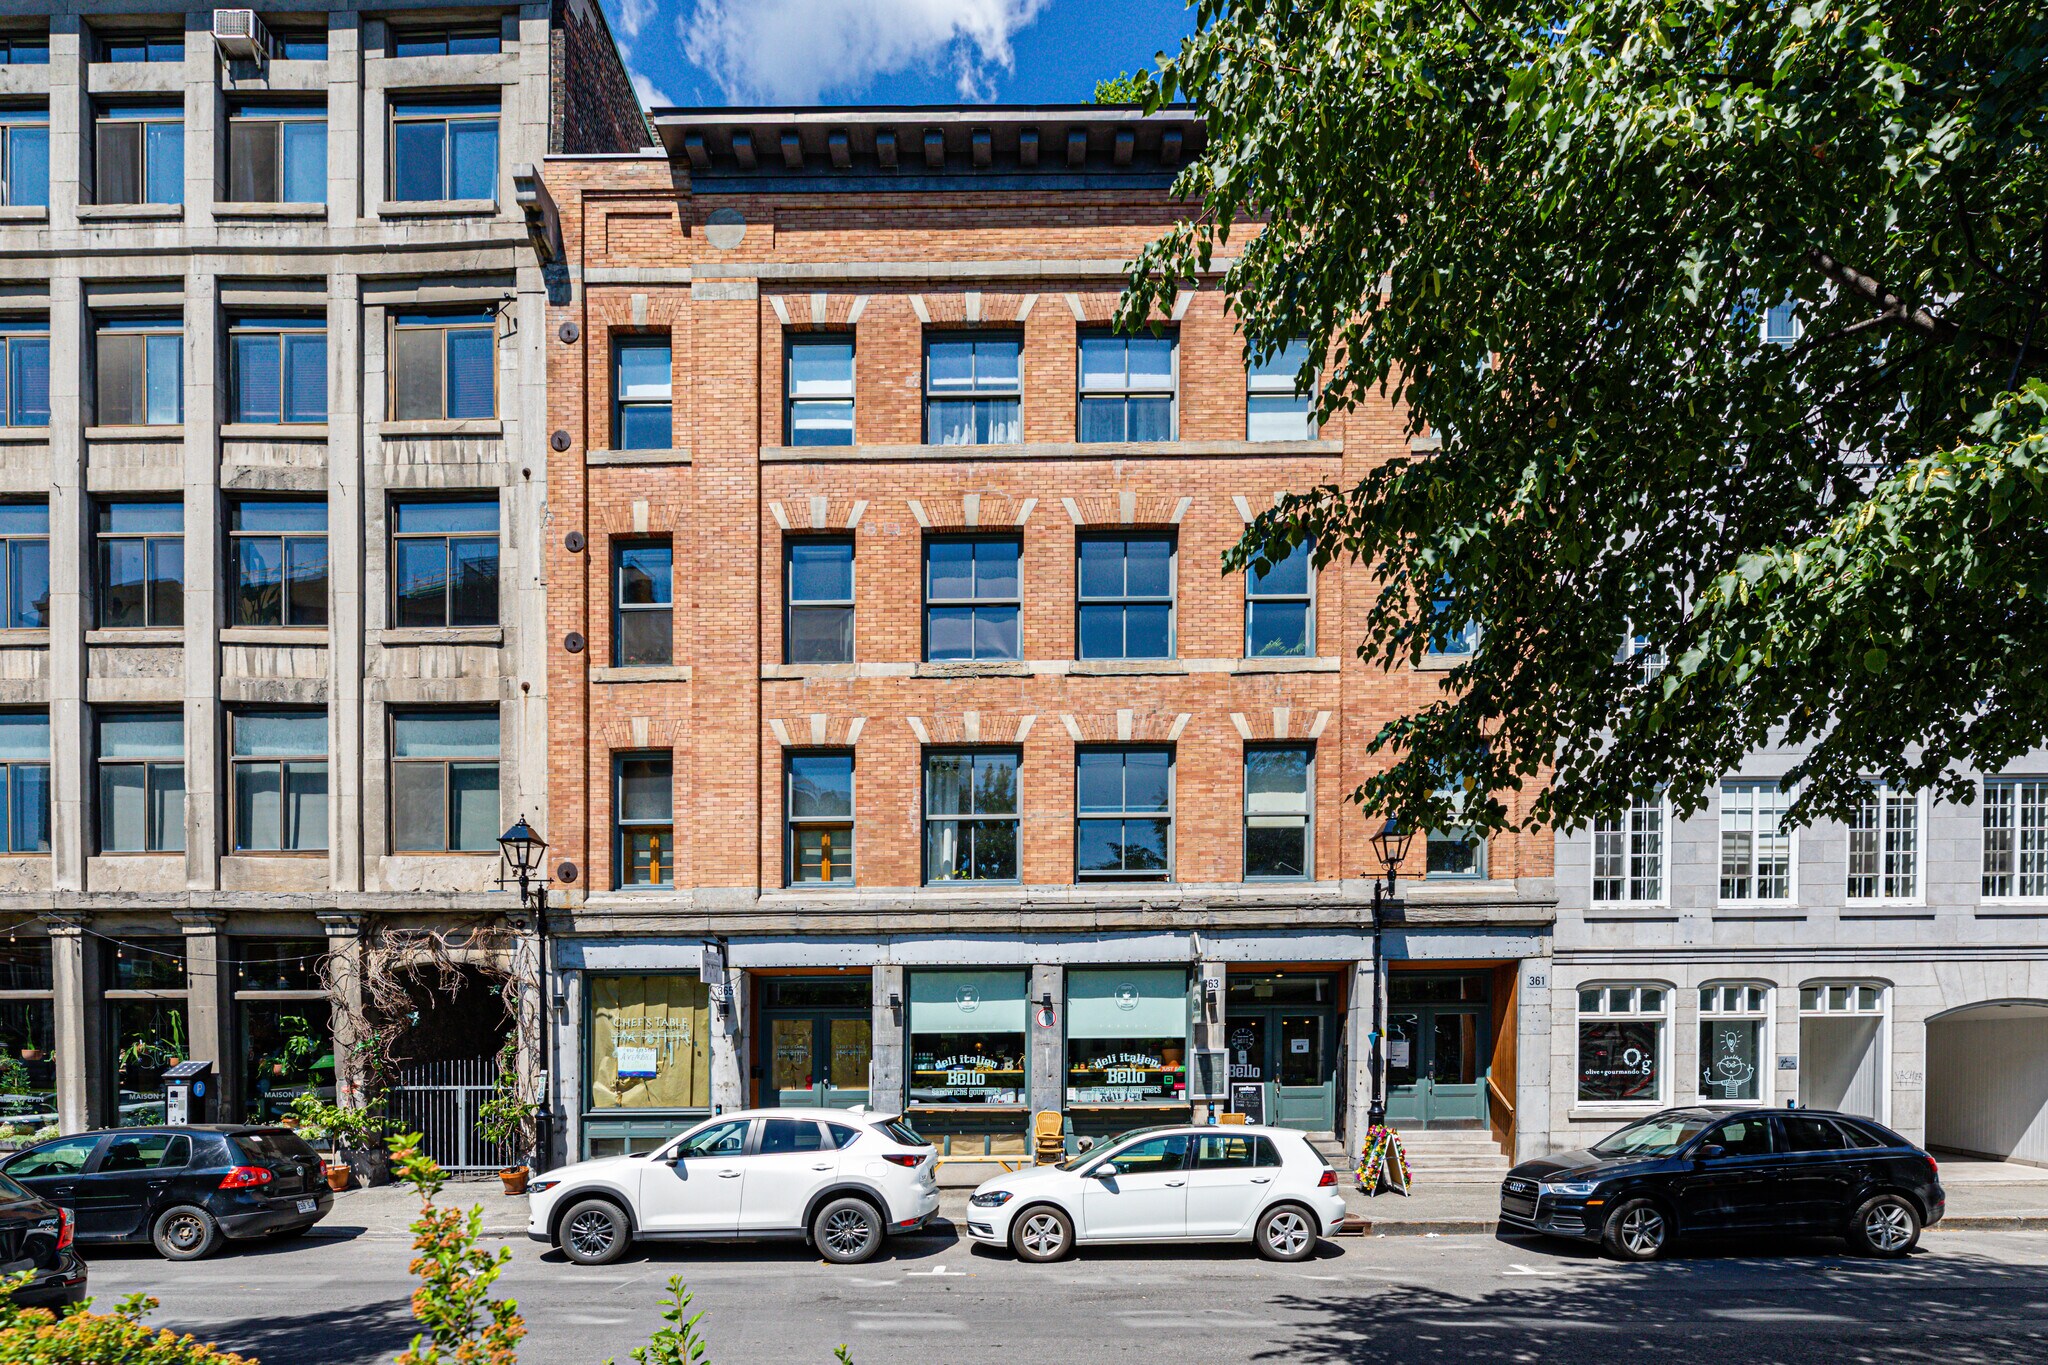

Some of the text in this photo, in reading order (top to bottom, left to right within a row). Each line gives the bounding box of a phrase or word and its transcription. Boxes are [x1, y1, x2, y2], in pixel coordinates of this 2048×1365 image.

[1529, 976, 1545, 986] 361
[718, 986, 734, 996] 365
[613, 1016, 688, 1028] CHEF'S TABLE
[935, 1054, 998, 1069] deli italien
[1095, 1053, 1159, 1069] deli italien
[946, 1070, 986, 1086] Bello
[1106, 1068, 1146, 1084] Bello
[931, 1087, 968, 1096] sandwichs
